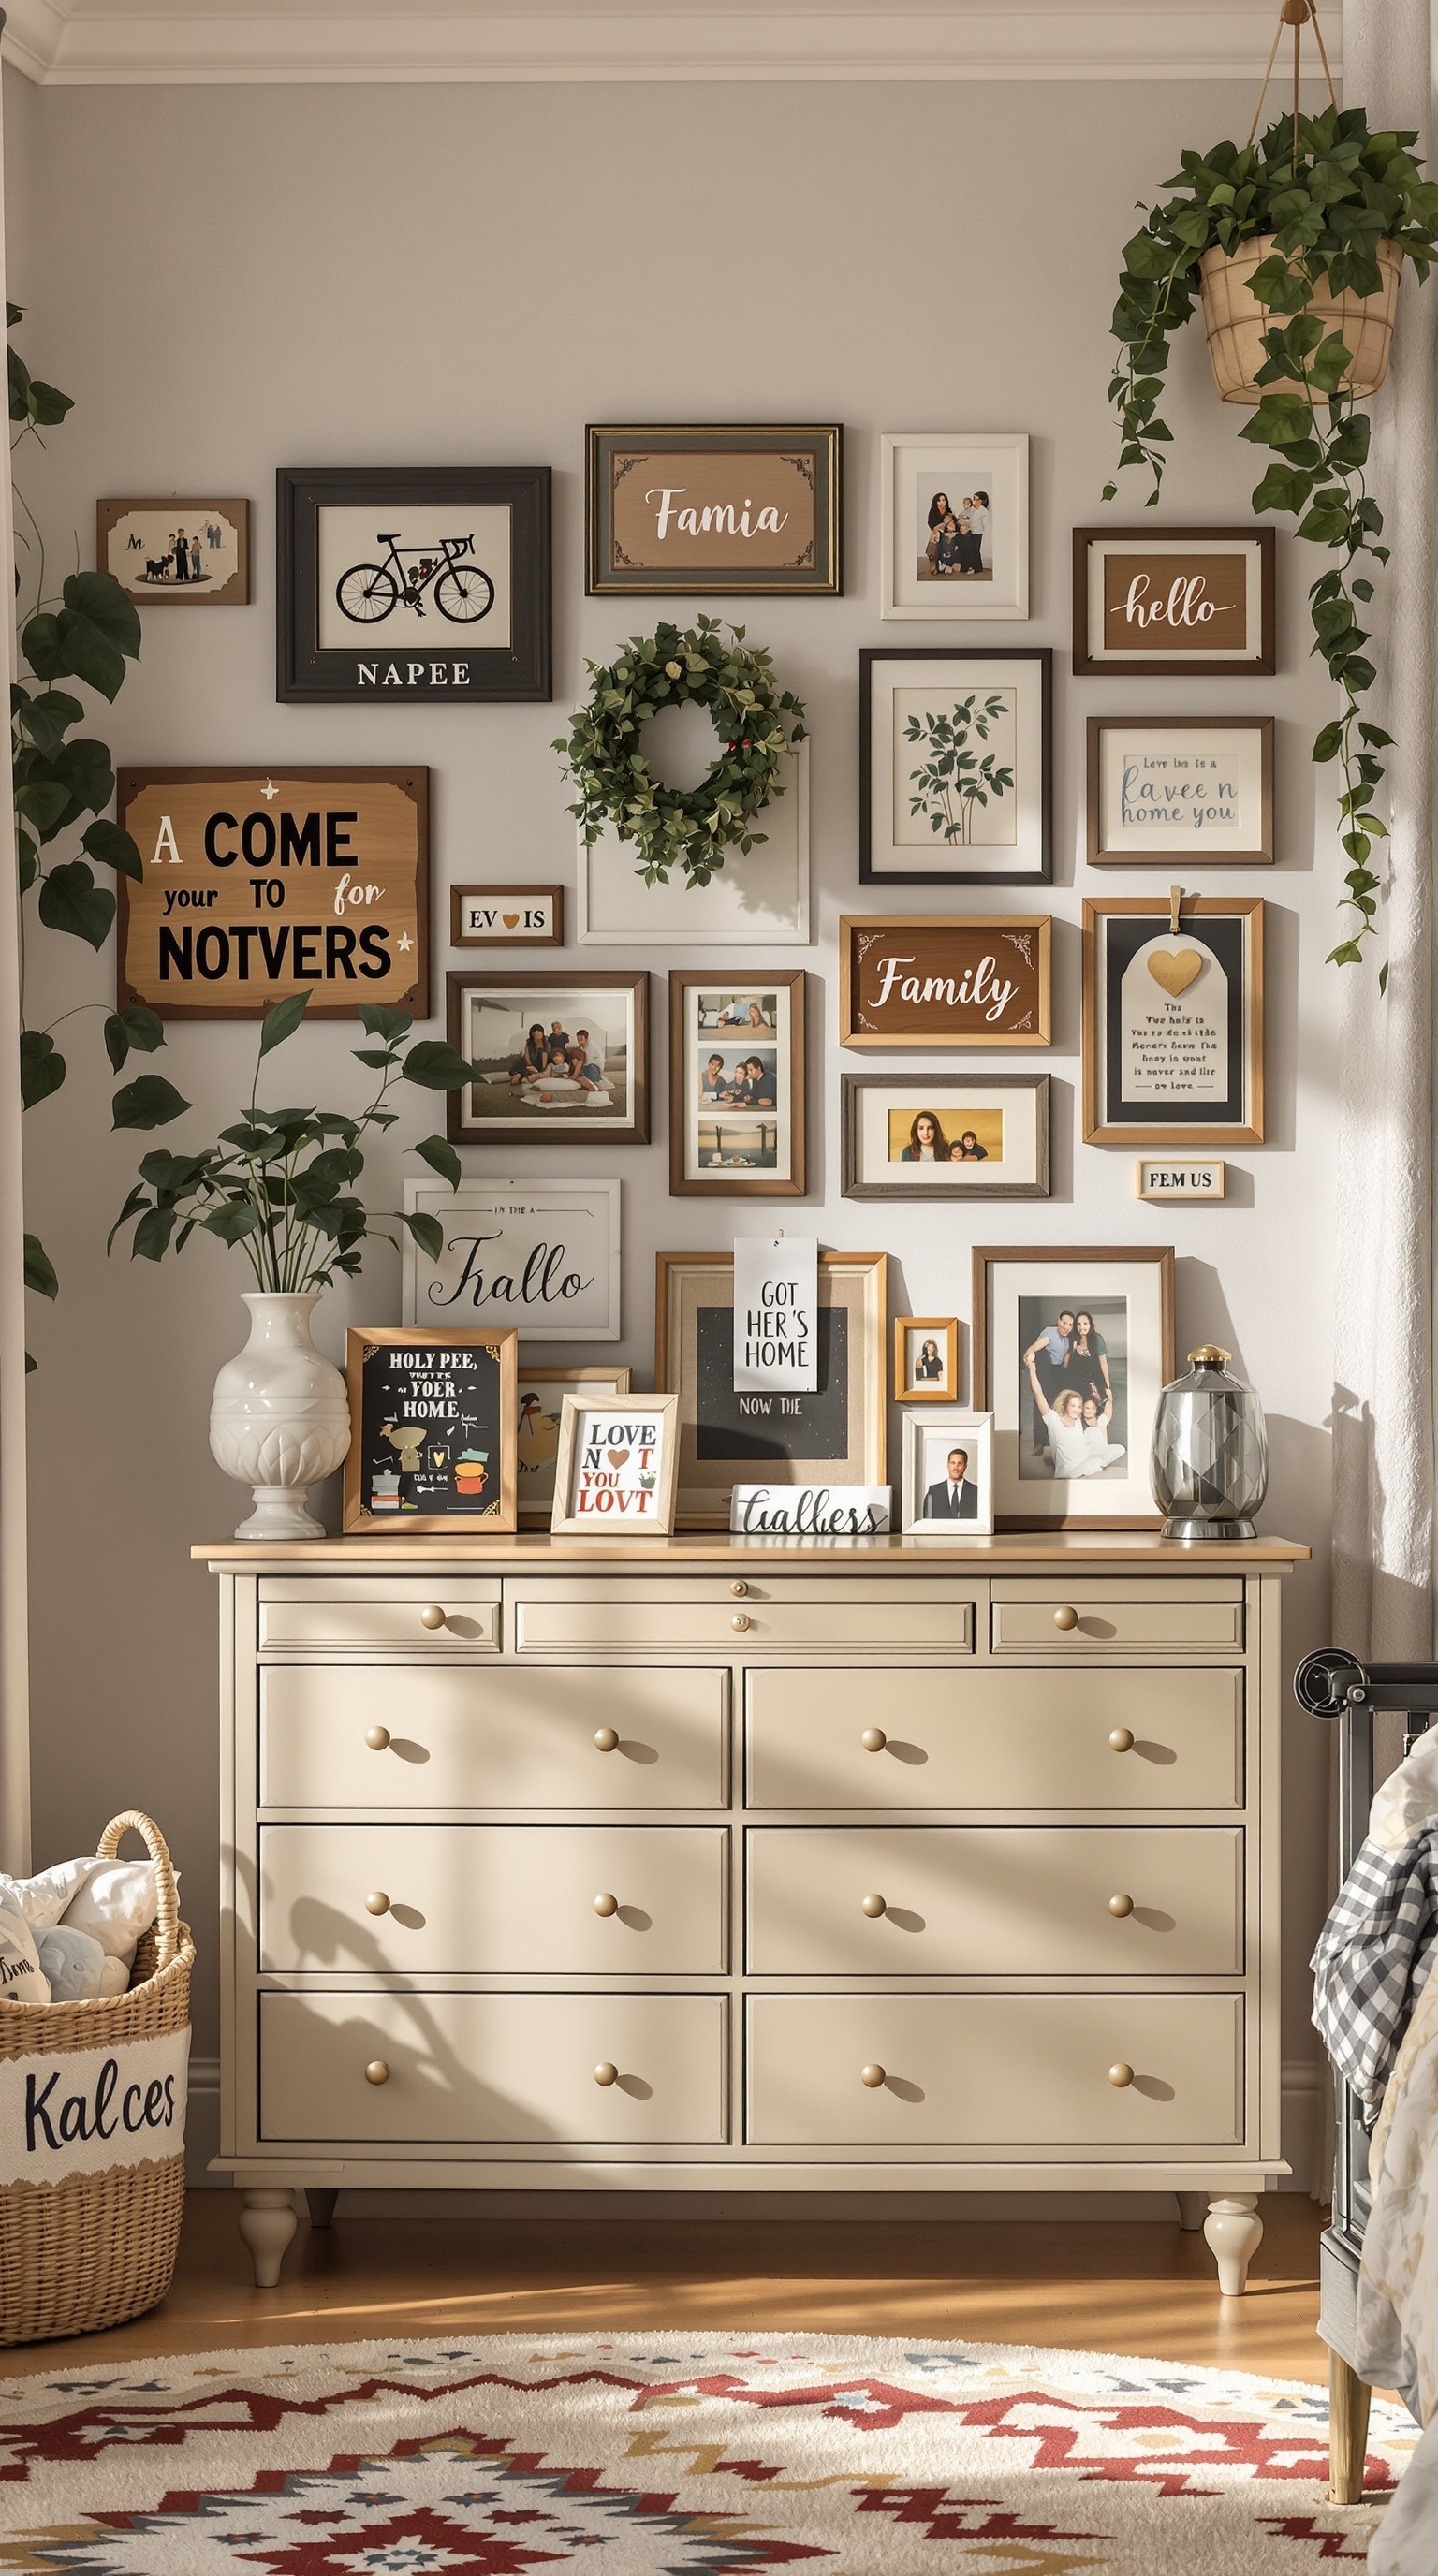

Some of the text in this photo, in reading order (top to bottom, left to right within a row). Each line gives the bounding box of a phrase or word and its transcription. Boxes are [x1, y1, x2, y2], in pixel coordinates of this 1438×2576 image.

[645, 488, 788, 541] Famia
[1110, 574, 1236, 628] hello
[358, 663, 471, 686] NAPEE
[1193, 806, 1236, 828] you
[150, 812, 359, 868] A COME
[162, 873, 386, 915] your TO for
[469, 909, 545, 929] EV IS
[158, 925, 392, 980] NOTVERS
[867, 955, 1020, 1022] Family
[1150, 1172, 1212, 1187] FEM US
[761, 1281, 799, 1308] GOT
[747, 1309, 809, 1339] HER'S
[389, 1352, 436, 1368] HOLY
[745, 1341, 810, 1368] HOME
[739, 1398, 772, 1415] NOW
[589, 1424, 657, 1446] LOVE
[582, 1472, 621, 1487] YOU
[577, 1489, 653, 1513] LOVT
[25, 2058, 176, 2153] Kalces
